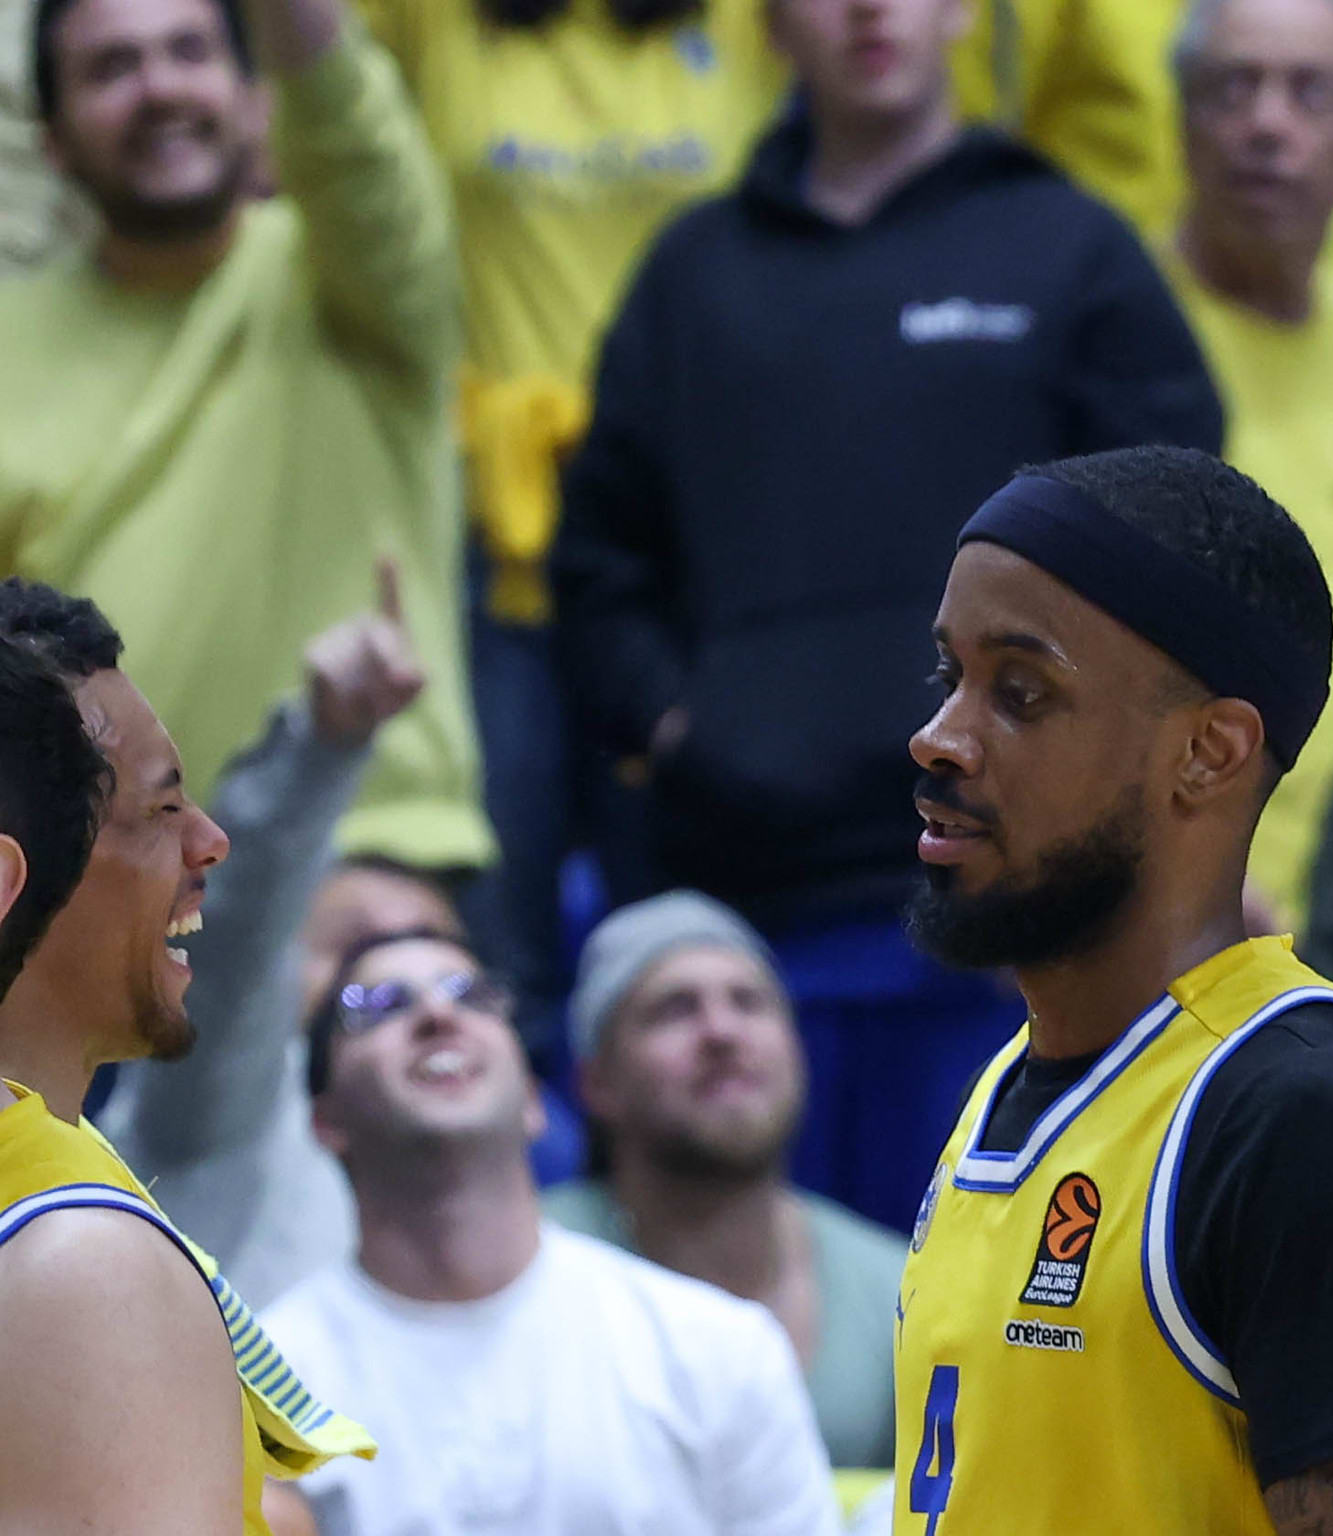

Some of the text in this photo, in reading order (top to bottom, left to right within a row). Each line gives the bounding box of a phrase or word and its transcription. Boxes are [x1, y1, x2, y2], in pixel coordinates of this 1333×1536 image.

[1037, 1260, 1081, 1278] TURKISH
[1030, 1274, 1078, 1292] AIRLINES
[1005, 1322, 1083, 1350] oneteam
